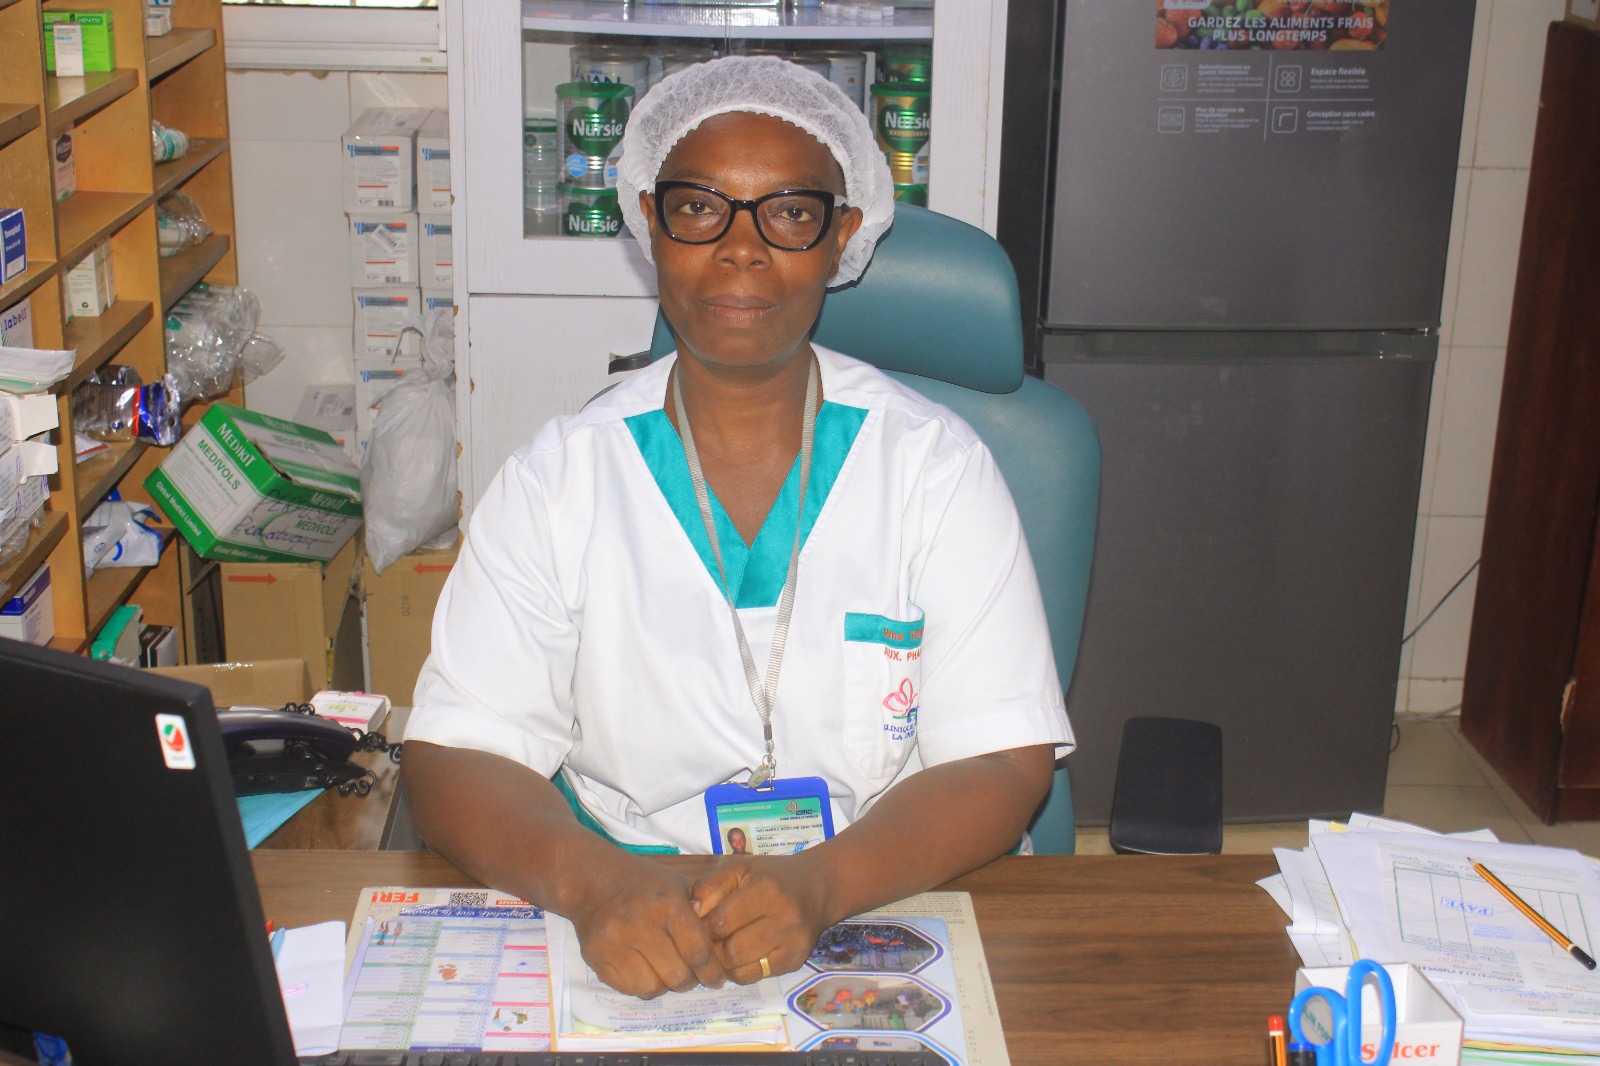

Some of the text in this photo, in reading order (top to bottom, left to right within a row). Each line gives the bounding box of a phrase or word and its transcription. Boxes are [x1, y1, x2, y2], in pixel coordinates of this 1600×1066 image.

[1187, 16, 1374, 28] GARDEZ LES ALIMENTS FRAIS
[1212, 31, 1327, 42] PLUS LONGTEMPS
[1311, 67, 1366, 77] Espace flexible
[1306, 110, 1342, 119] Conception
[572, 119, 623, 137] Nursie
[568, 214, 618, 233] Nursie
[216, 422, 256, 468] MEDIKIT
[197, 439, 241, 490] MEDIVOLS
[371, 891, 419, 903] FER!
[1445, 899, 1488, 917] PAYE
[1361, 1042, 1440, 1061] Slcer
